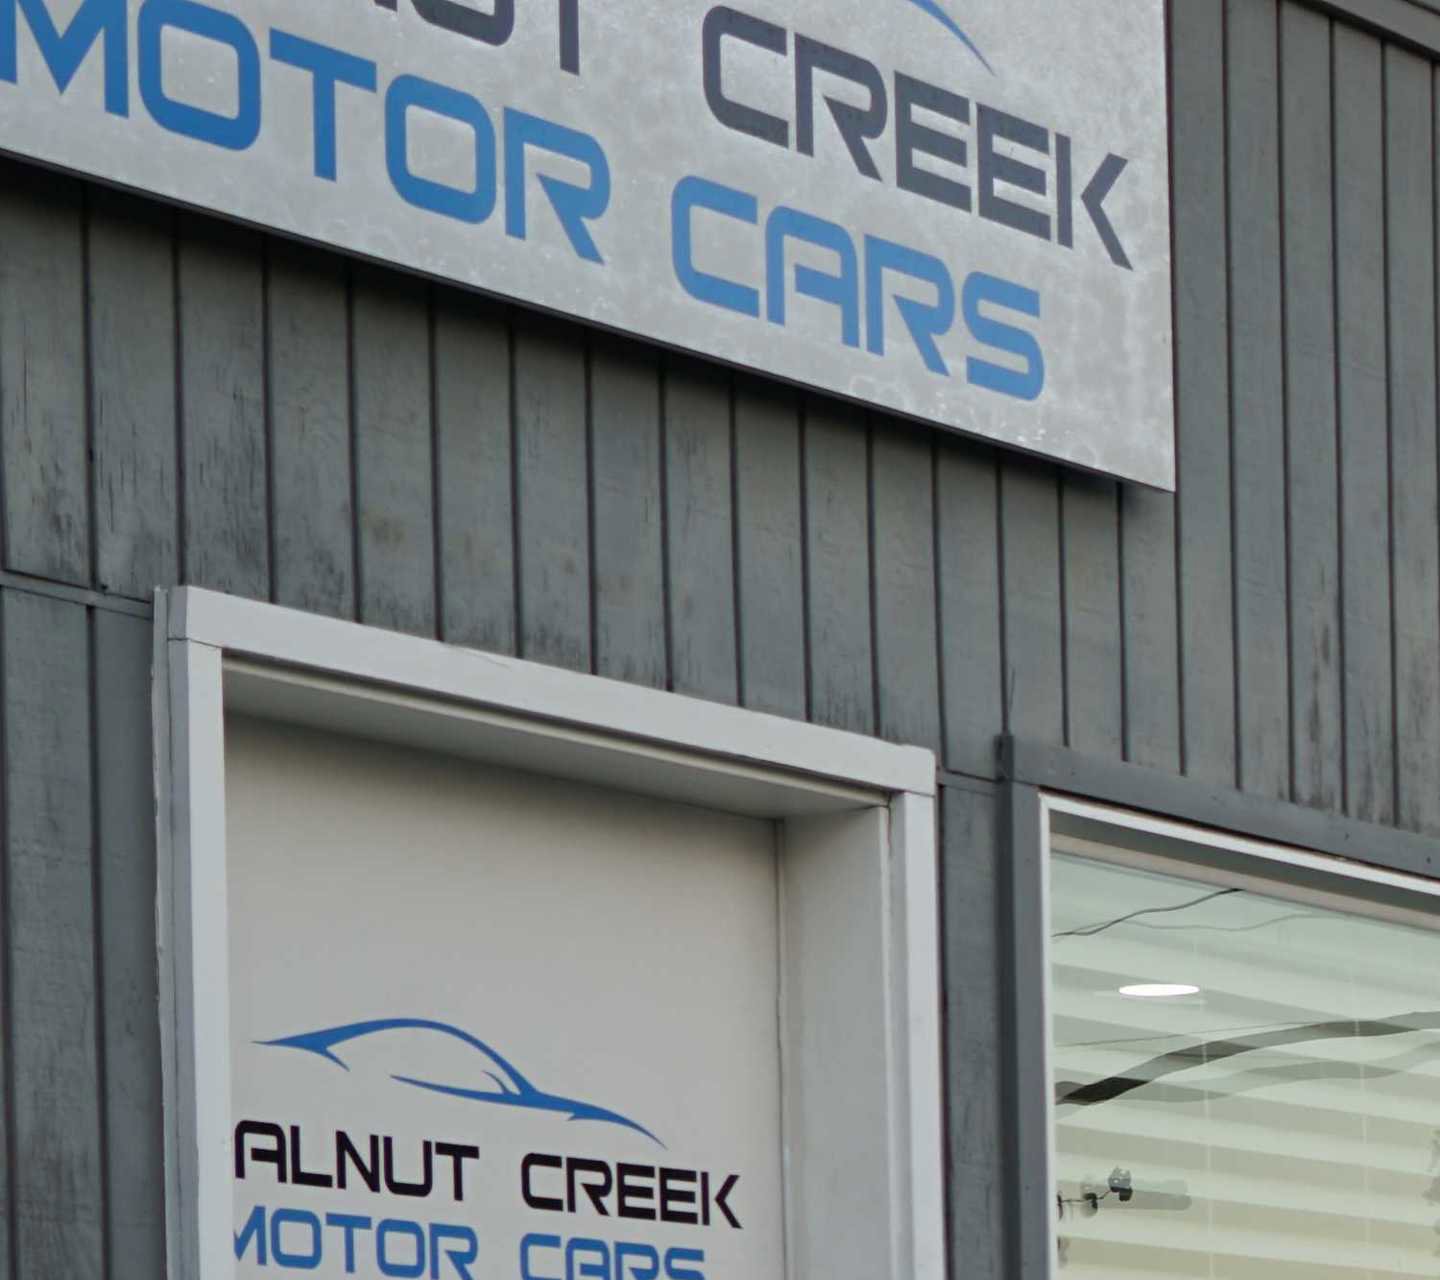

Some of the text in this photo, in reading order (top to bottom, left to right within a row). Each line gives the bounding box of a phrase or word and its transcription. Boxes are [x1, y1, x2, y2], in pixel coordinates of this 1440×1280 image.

[0, 0, 1045, 401] MOTOR CARS
[702, 4, 1134, 270] CREEK
[234, 1119, 743, 1229] ALNUT CREEK
